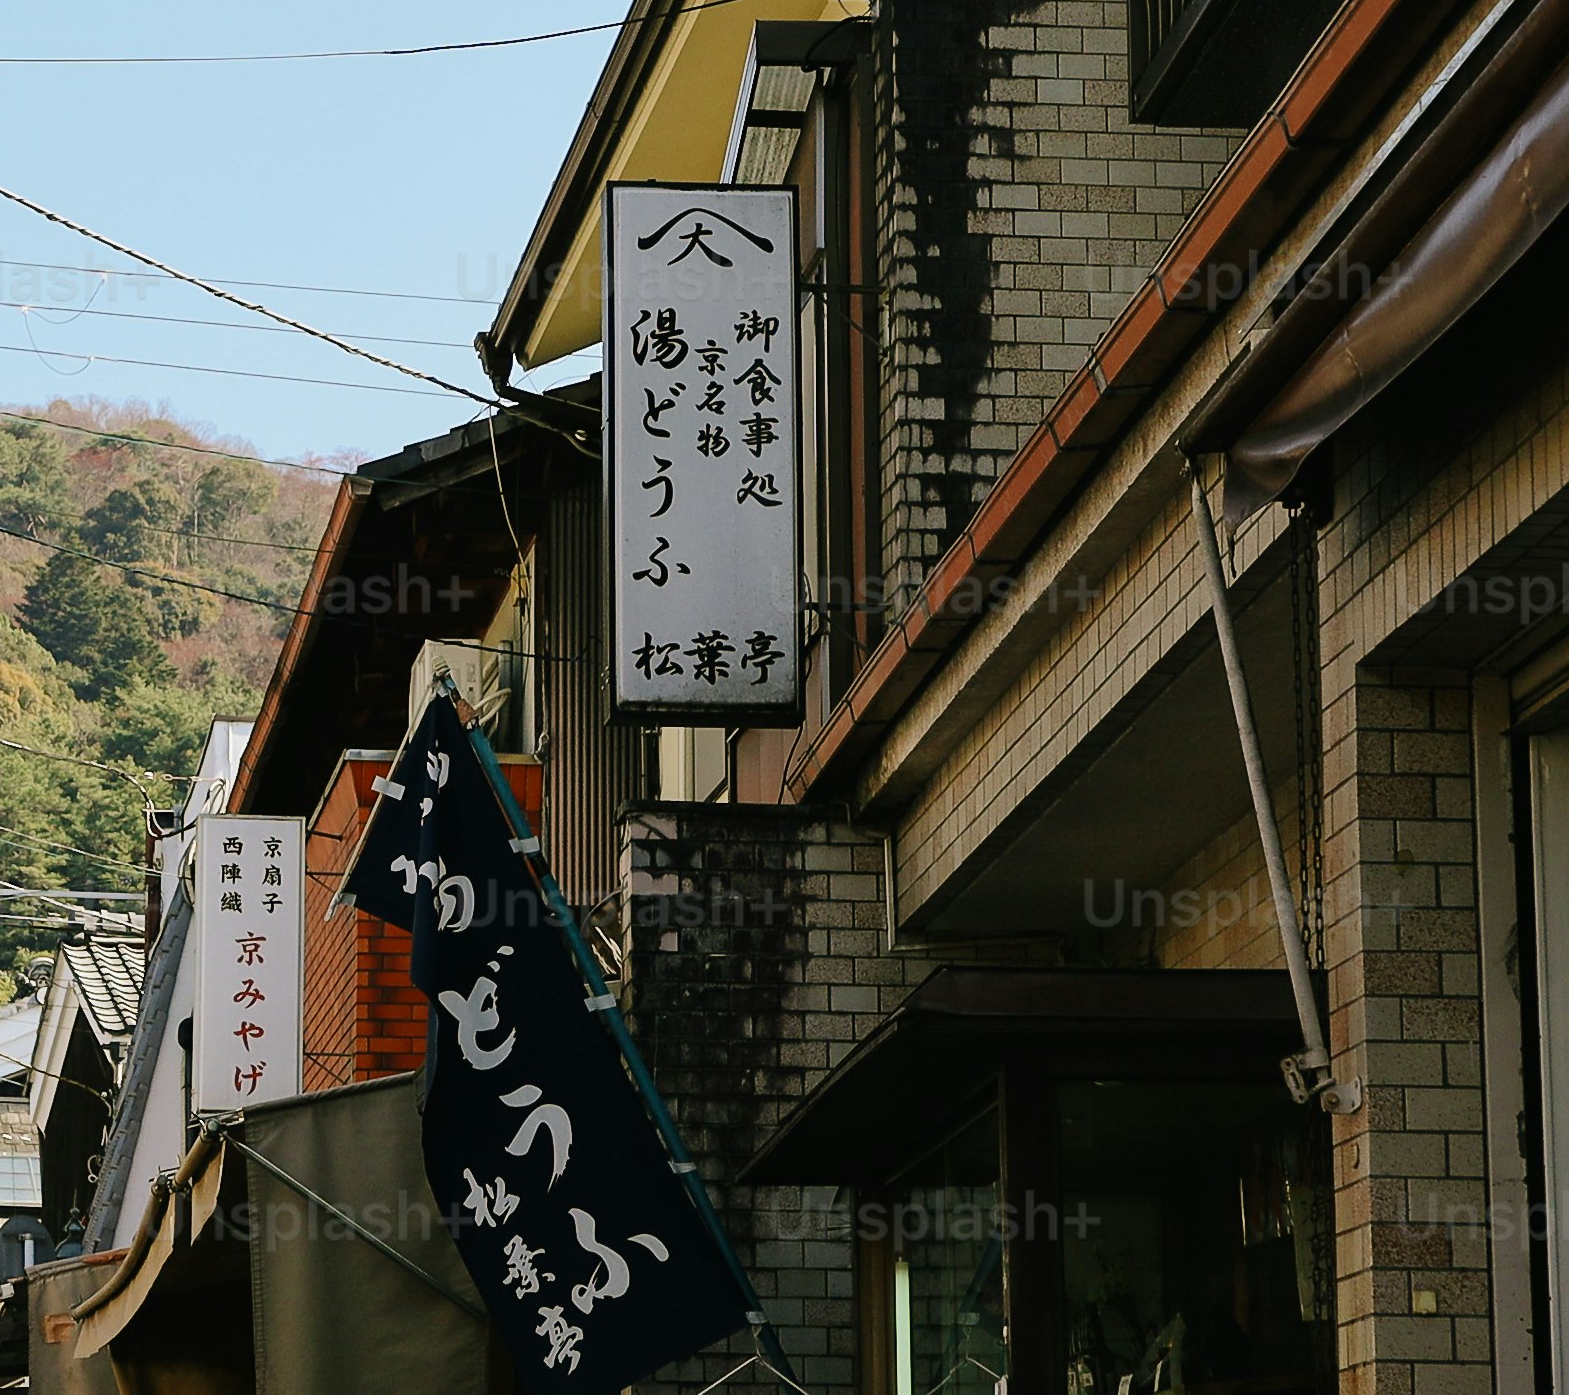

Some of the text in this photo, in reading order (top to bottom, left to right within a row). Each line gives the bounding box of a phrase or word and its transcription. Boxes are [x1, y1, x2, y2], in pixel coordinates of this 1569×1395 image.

[630, 307, 693, 589] 湯どうふ
[694, 338, 732, 460] 京名物
[733, 309, 784, 509] 御食事処
[632, 628, 787, 687] 松葉亭
[220, 835, 244, 914] 西陣織
[260, 835, 284, 914] 京扇子
[232, 930, 268, 1096] 京みやげ
[462, 1166, 584, 1377] 松葉亭
